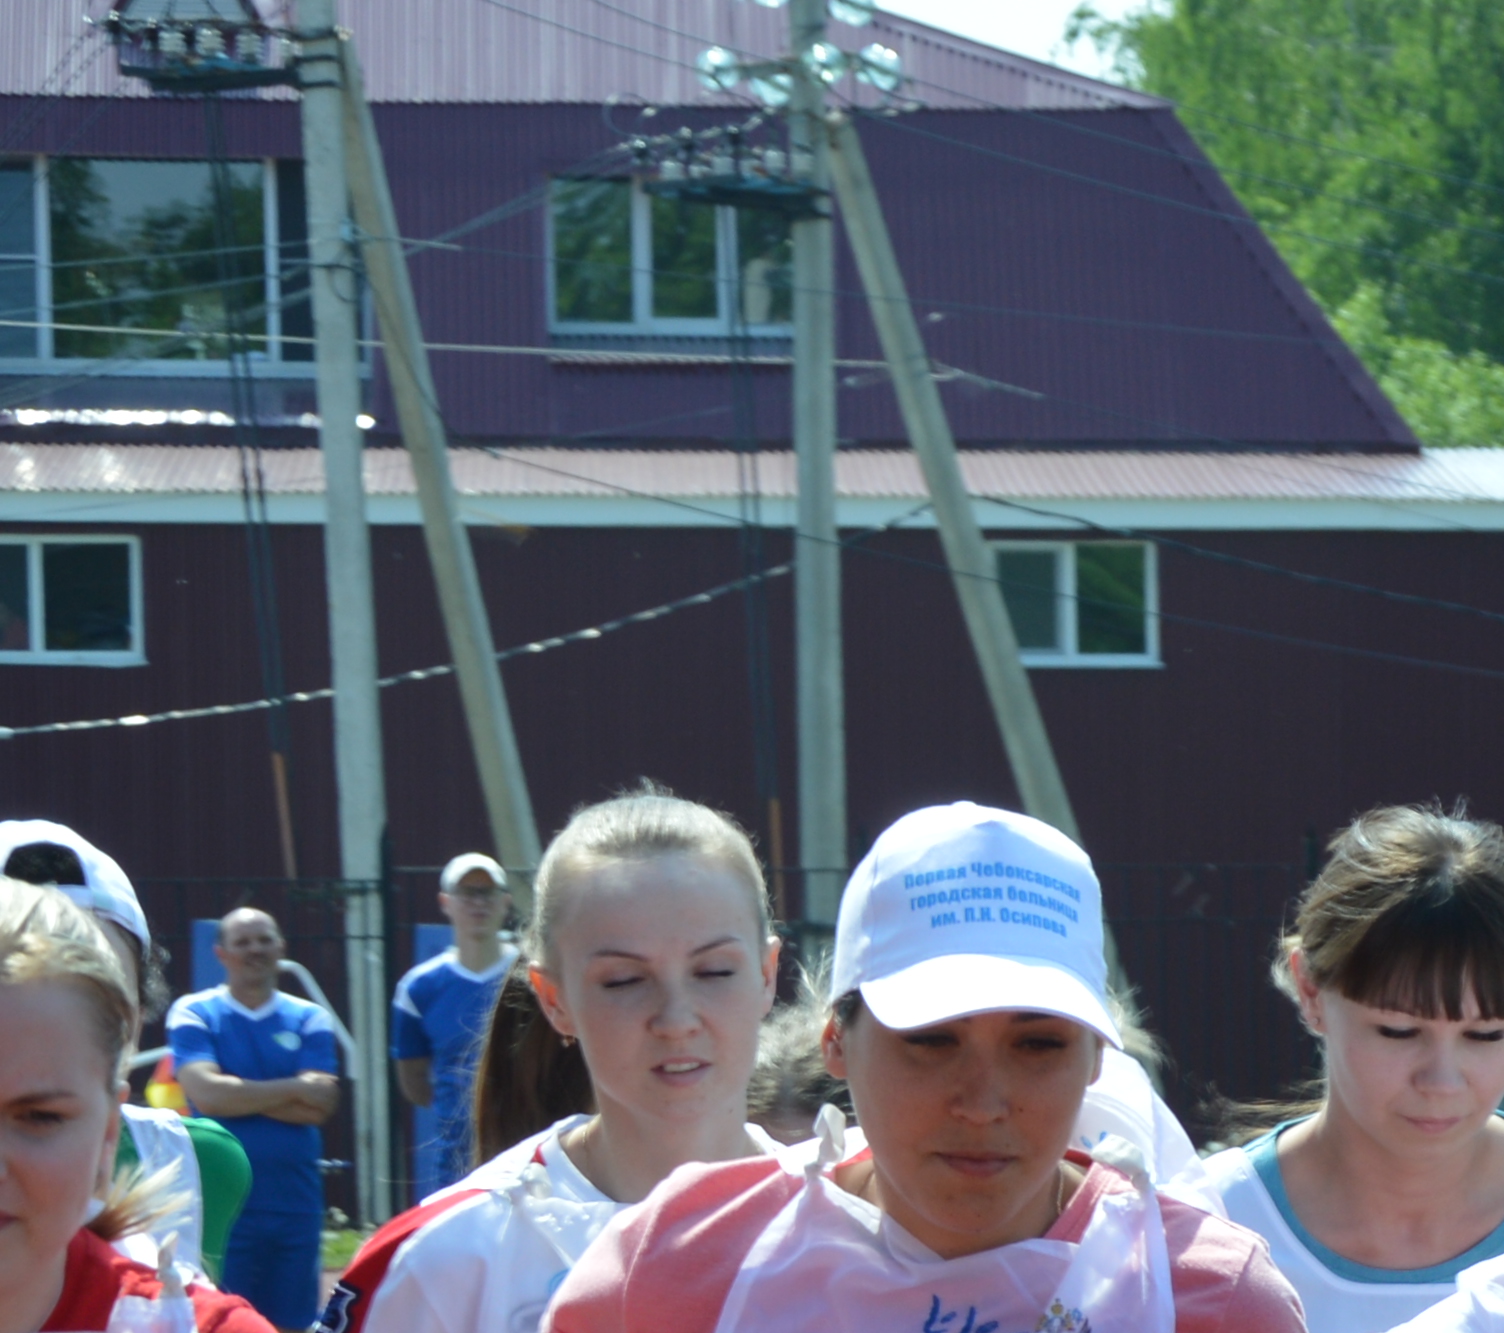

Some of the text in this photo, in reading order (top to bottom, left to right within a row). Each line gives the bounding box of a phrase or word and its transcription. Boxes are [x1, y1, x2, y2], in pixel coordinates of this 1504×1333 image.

[904, 861, 1081, 903] Первая Чебоксарская
[911, 885, 1079, 924] городская больница
[1000, 907, 1067, 938] Осипова
